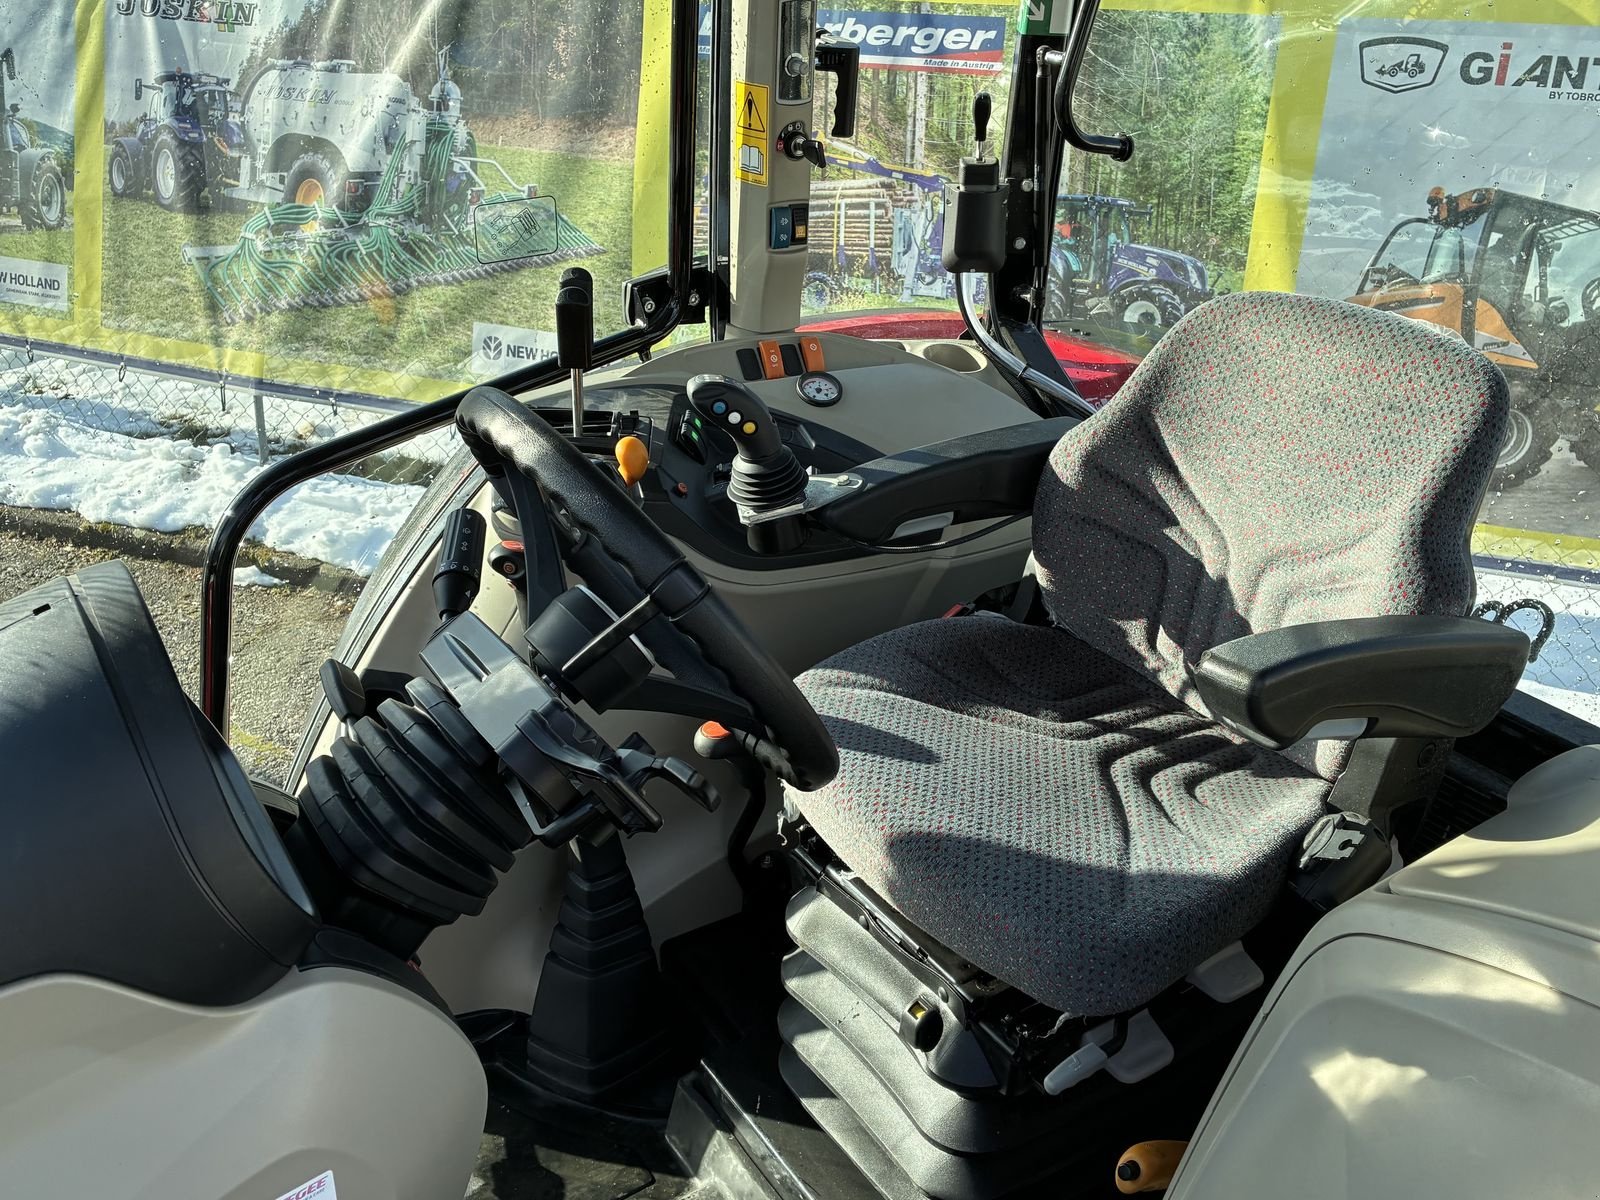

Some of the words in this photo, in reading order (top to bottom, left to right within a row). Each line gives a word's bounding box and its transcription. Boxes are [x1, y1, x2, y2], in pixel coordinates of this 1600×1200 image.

[116, 0, 257, 26] JOSKIN
[816, 17, 997, 54] rberger
[924, 59, 948, 67] Made
[1549, 91, 1563, 99] BY
[9, 272, 60, 291] HOLLAND
[506, 344, 538, 360] NEW
